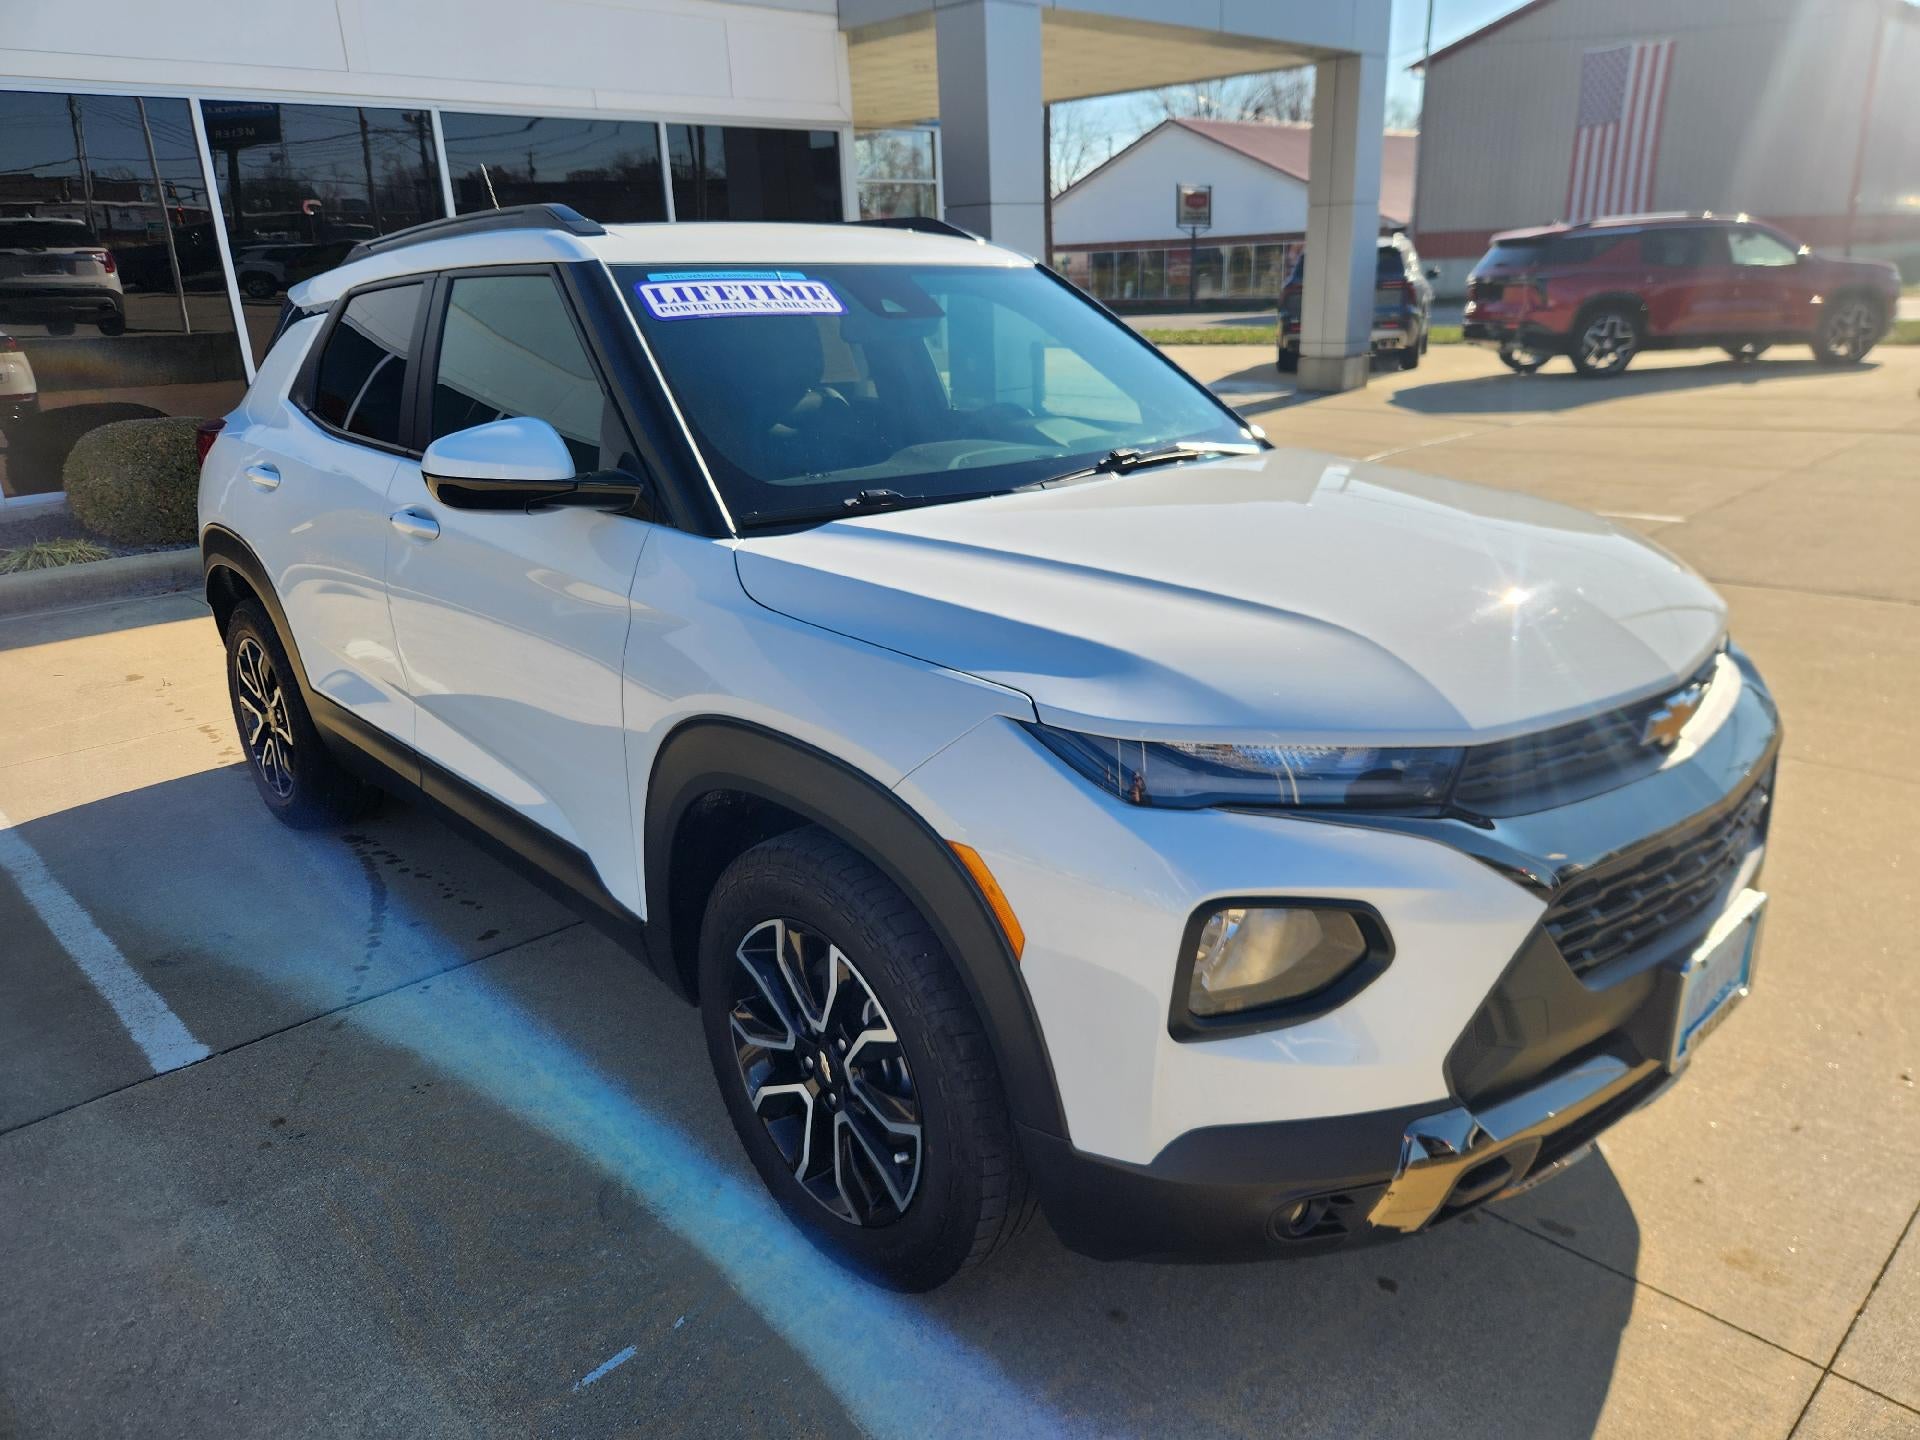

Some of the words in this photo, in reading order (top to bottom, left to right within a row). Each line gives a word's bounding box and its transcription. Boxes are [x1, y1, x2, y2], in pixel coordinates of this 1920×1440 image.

[649, 285, 830, 304] LIFETIME
[659, 302, 759, 313] POWERTRAIN
[762, 302, 836, 310] WARRANTY
